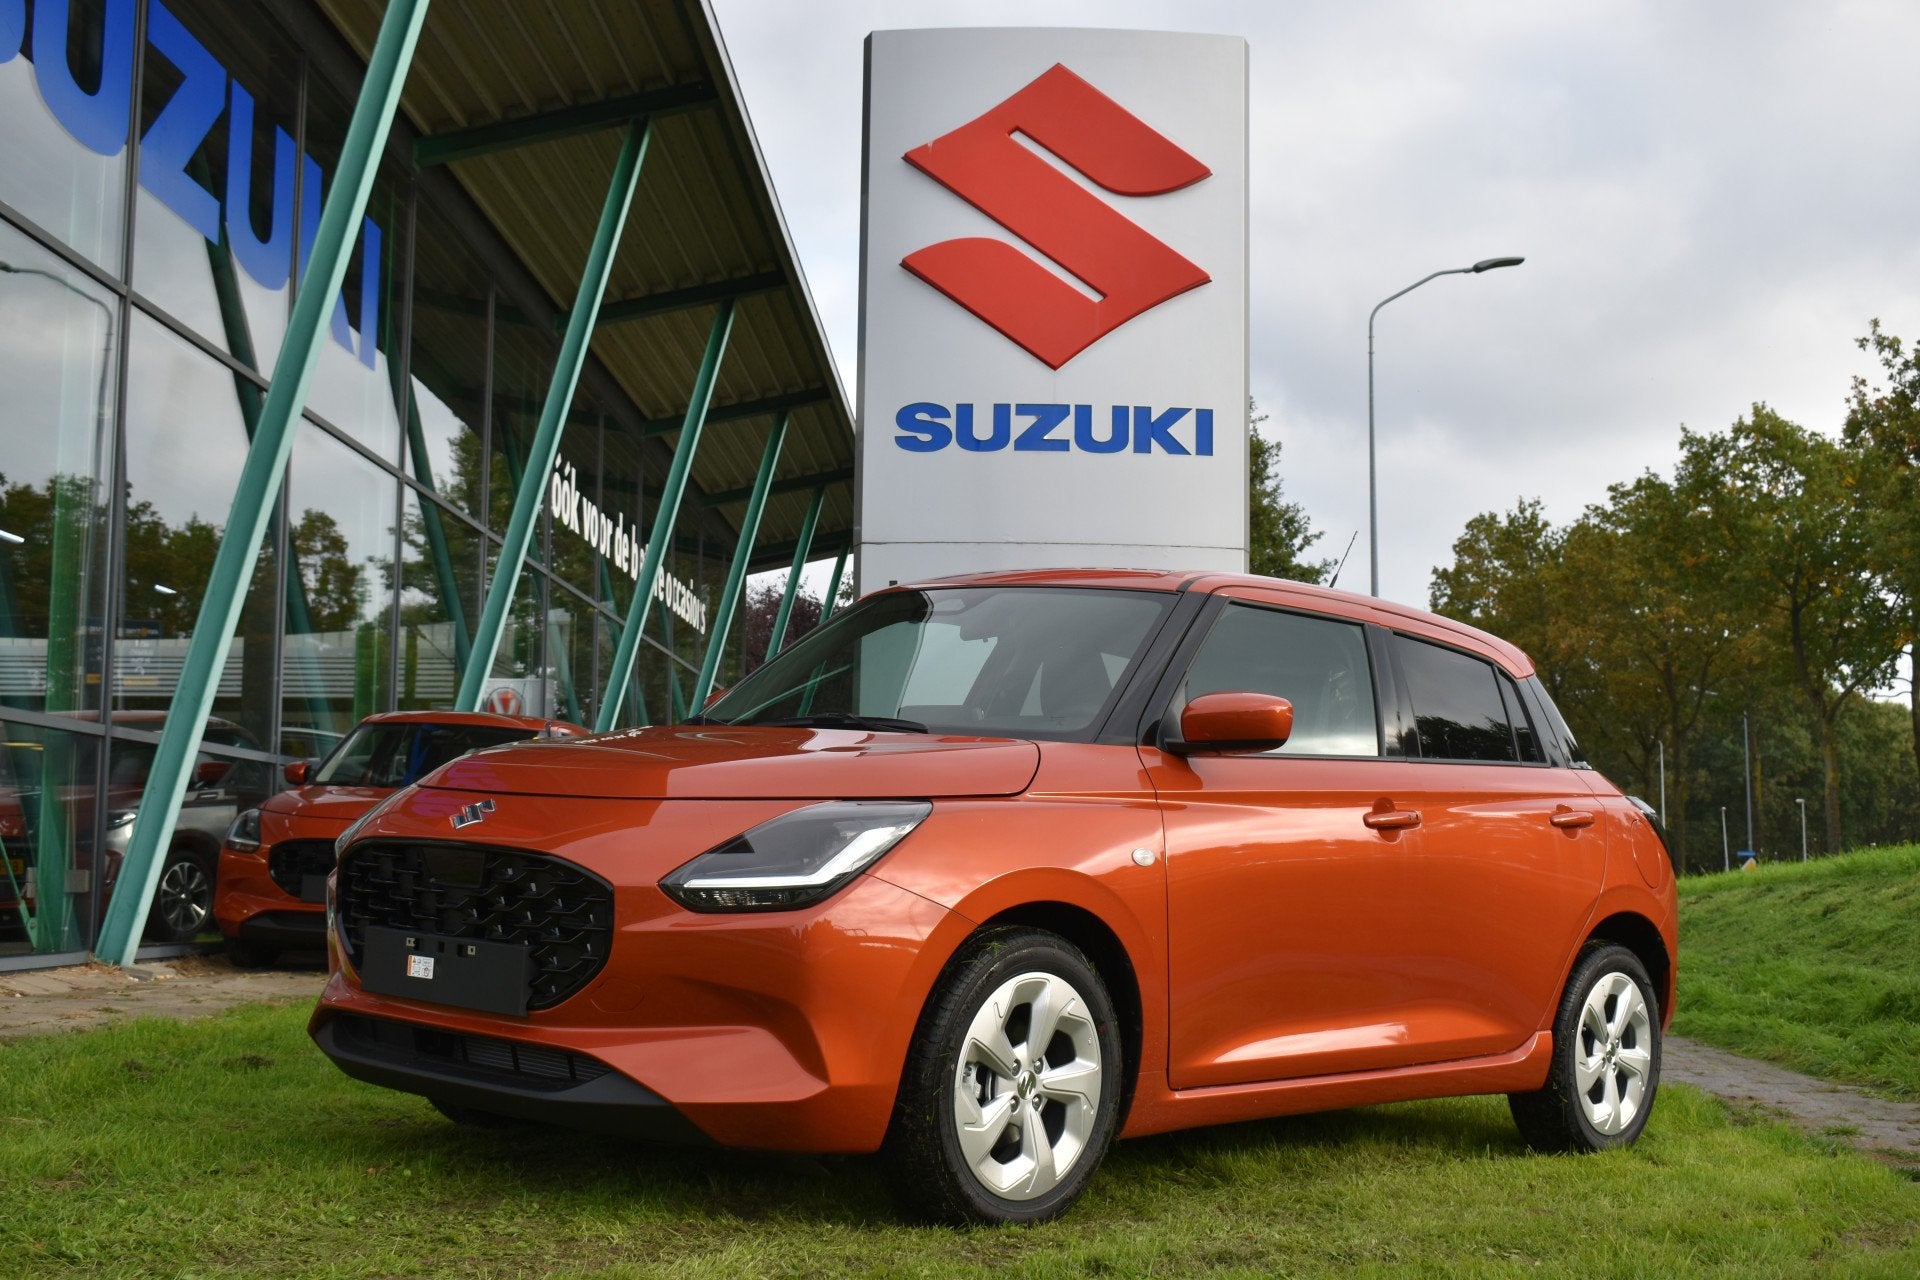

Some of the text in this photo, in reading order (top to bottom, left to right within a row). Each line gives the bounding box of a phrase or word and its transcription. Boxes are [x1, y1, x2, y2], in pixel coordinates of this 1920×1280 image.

[0, 0, 381, 371] UZUI
[894, 402, 1214, 456] SUZUKI
[582, 496, 613, 559] voor
[614, 512, 630, 573] de
[665, 572, 706, 635] occasions
